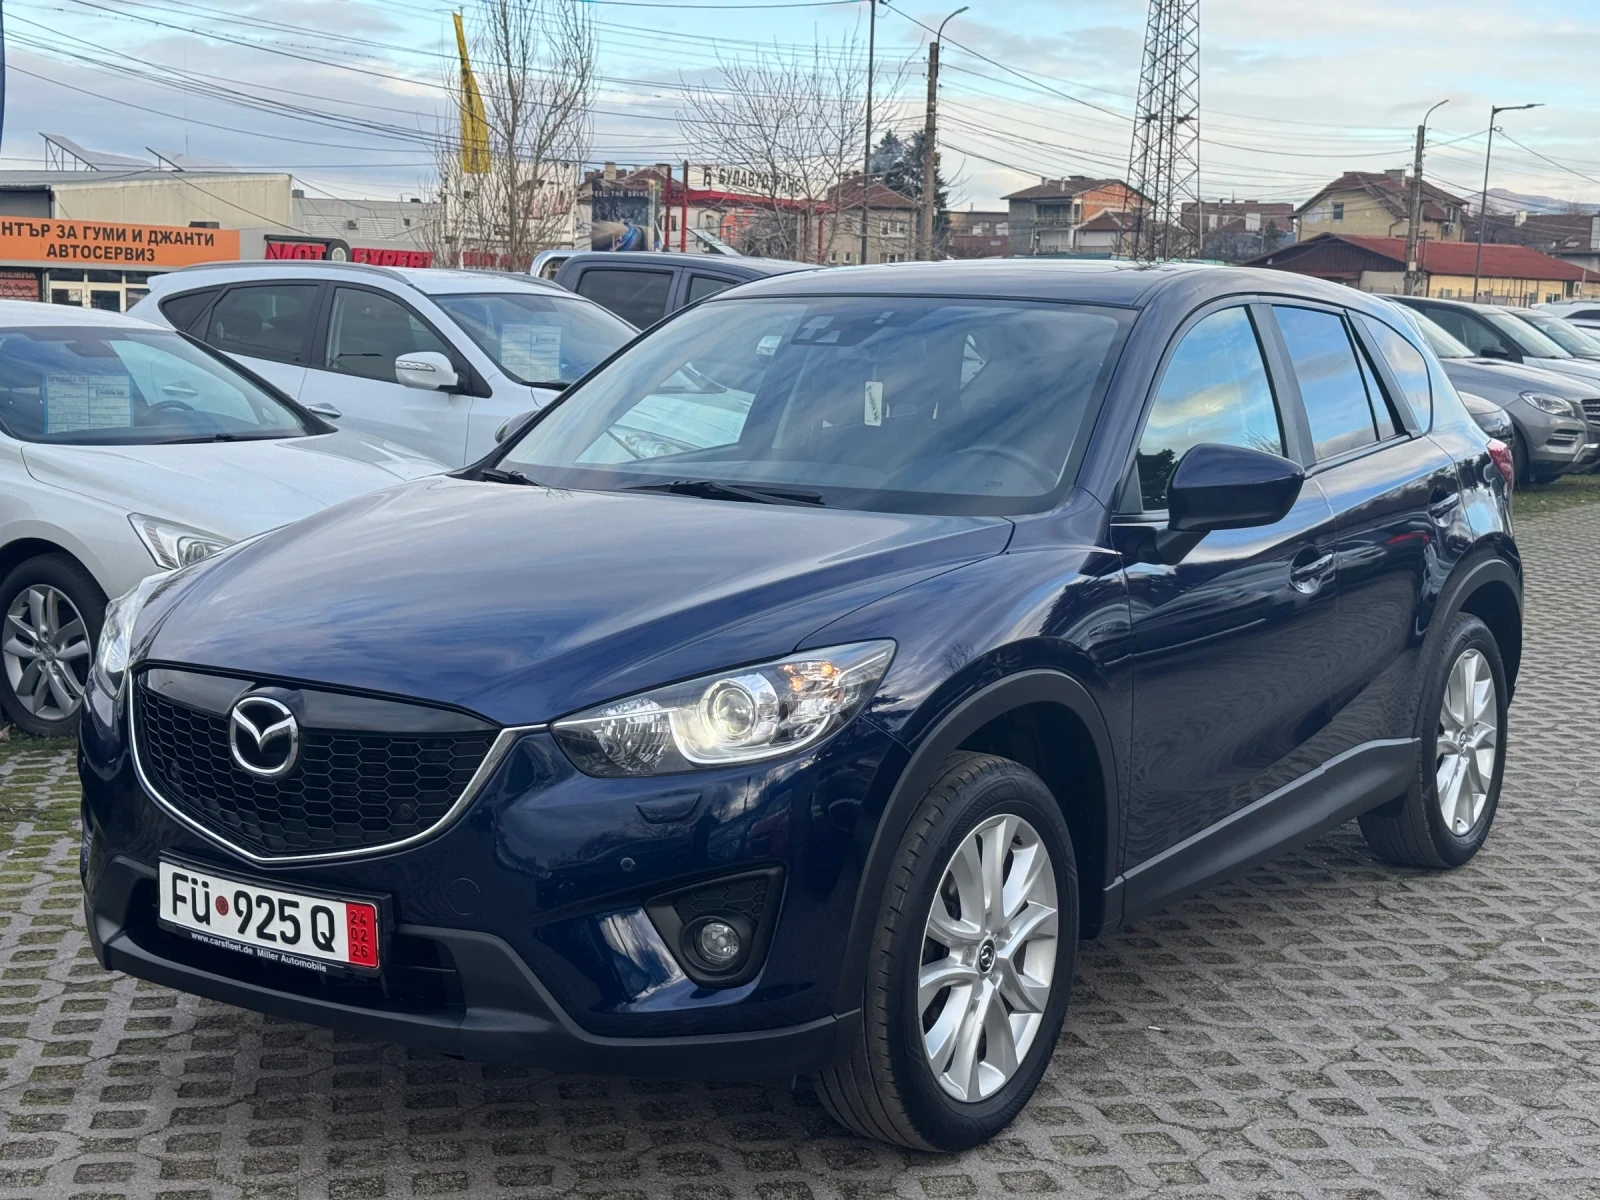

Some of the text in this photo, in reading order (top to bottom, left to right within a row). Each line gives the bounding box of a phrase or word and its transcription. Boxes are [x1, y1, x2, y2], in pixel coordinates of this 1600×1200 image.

[610, 190, 624, 198] THE
[627, 190, 649, 198] DRIVE
[0, 221, 215, 247] НТЪР ЗА ГУМИ И ДЖАНТИ
[46, 243, 155, 262] АВТОСЕРВИЗ
[172, 871, 336, 953] FÜ 925 Q
[350, 909, 367, 926] 24
[350, 925, 368, 942] 02
[190, 931, 327, 973] www.carsfleet.de Miller Automobile
[351, 943, 369, 958] 26
